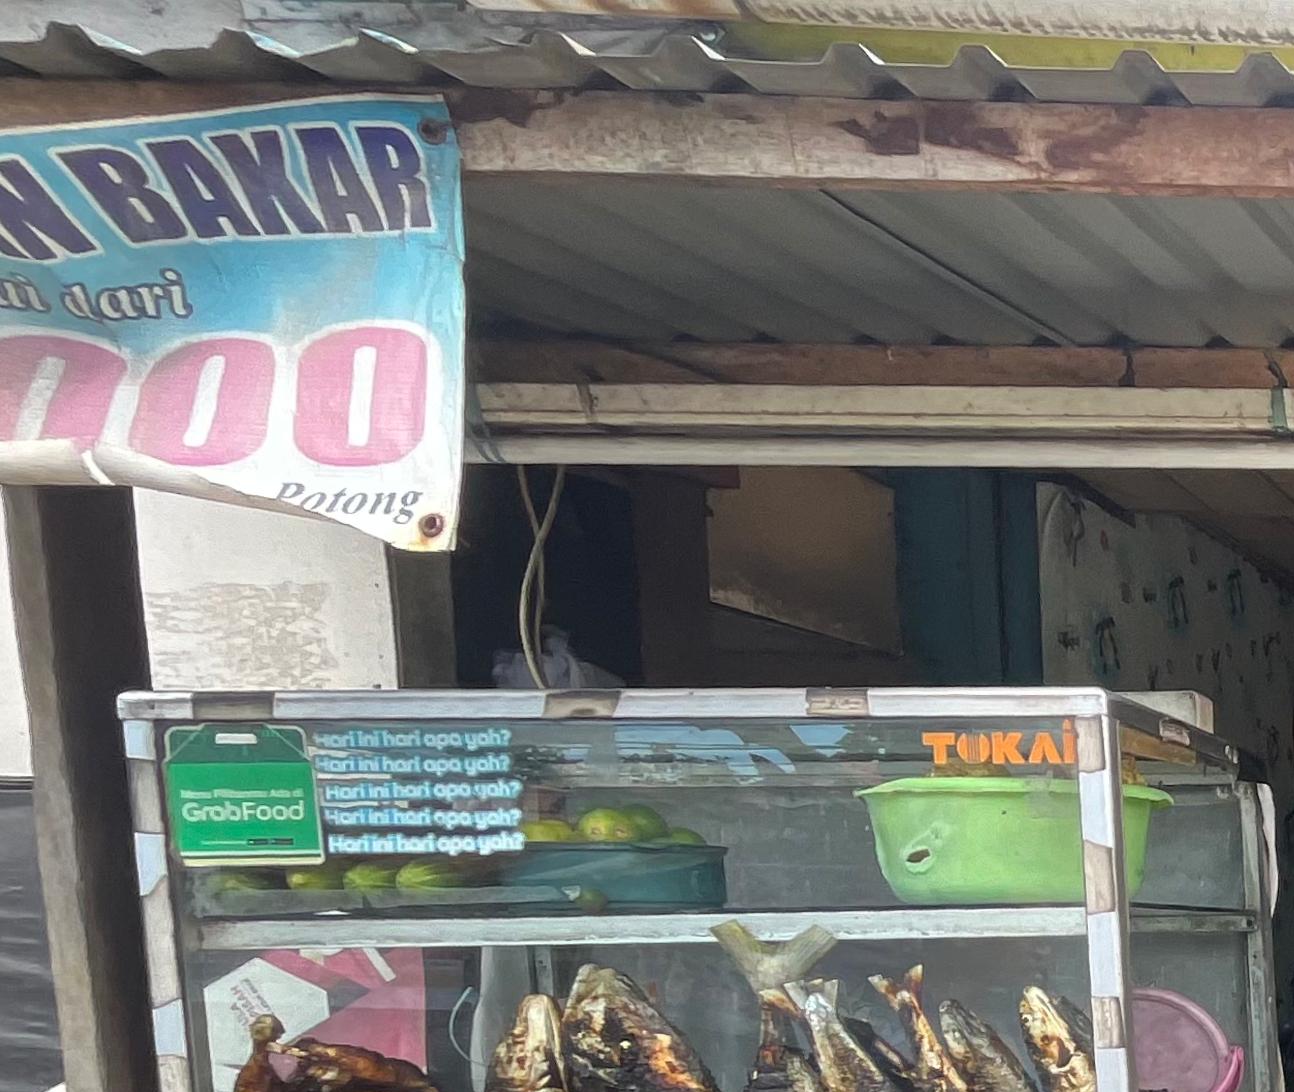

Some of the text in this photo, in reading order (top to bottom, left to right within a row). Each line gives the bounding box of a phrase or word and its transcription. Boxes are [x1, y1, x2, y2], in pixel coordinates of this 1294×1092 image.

[0, 120, 436, 263] N BAKAR
[60, 267, 193, 321] dari
[181, 800, 304, 822] GrabFood
